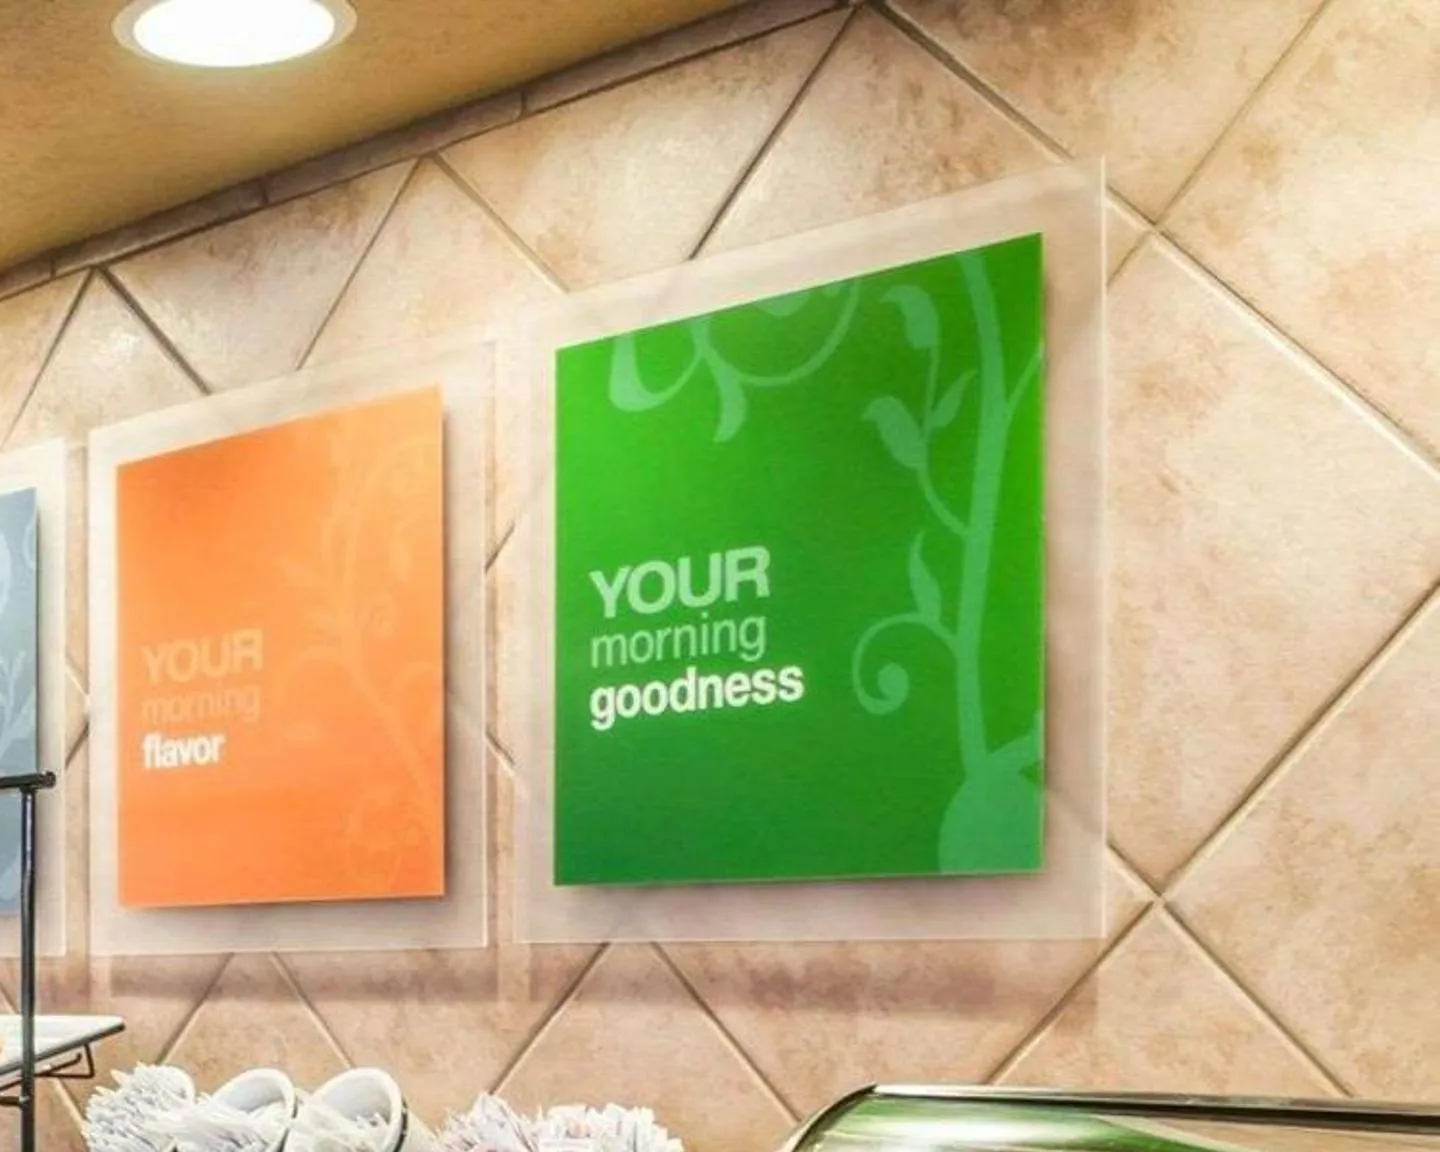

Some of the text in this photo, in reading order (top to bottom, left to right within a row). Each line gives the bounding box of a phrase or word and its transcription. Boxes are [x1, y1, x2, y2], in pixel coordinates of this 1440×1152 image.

[589, 546, 771, 618] YOUR
[140, 628, 264, 685] YOUR
[591, 611, 767, 669] morning
[589, 665, 805, 731] goodness
[143, 732, 226, 770] flavor
